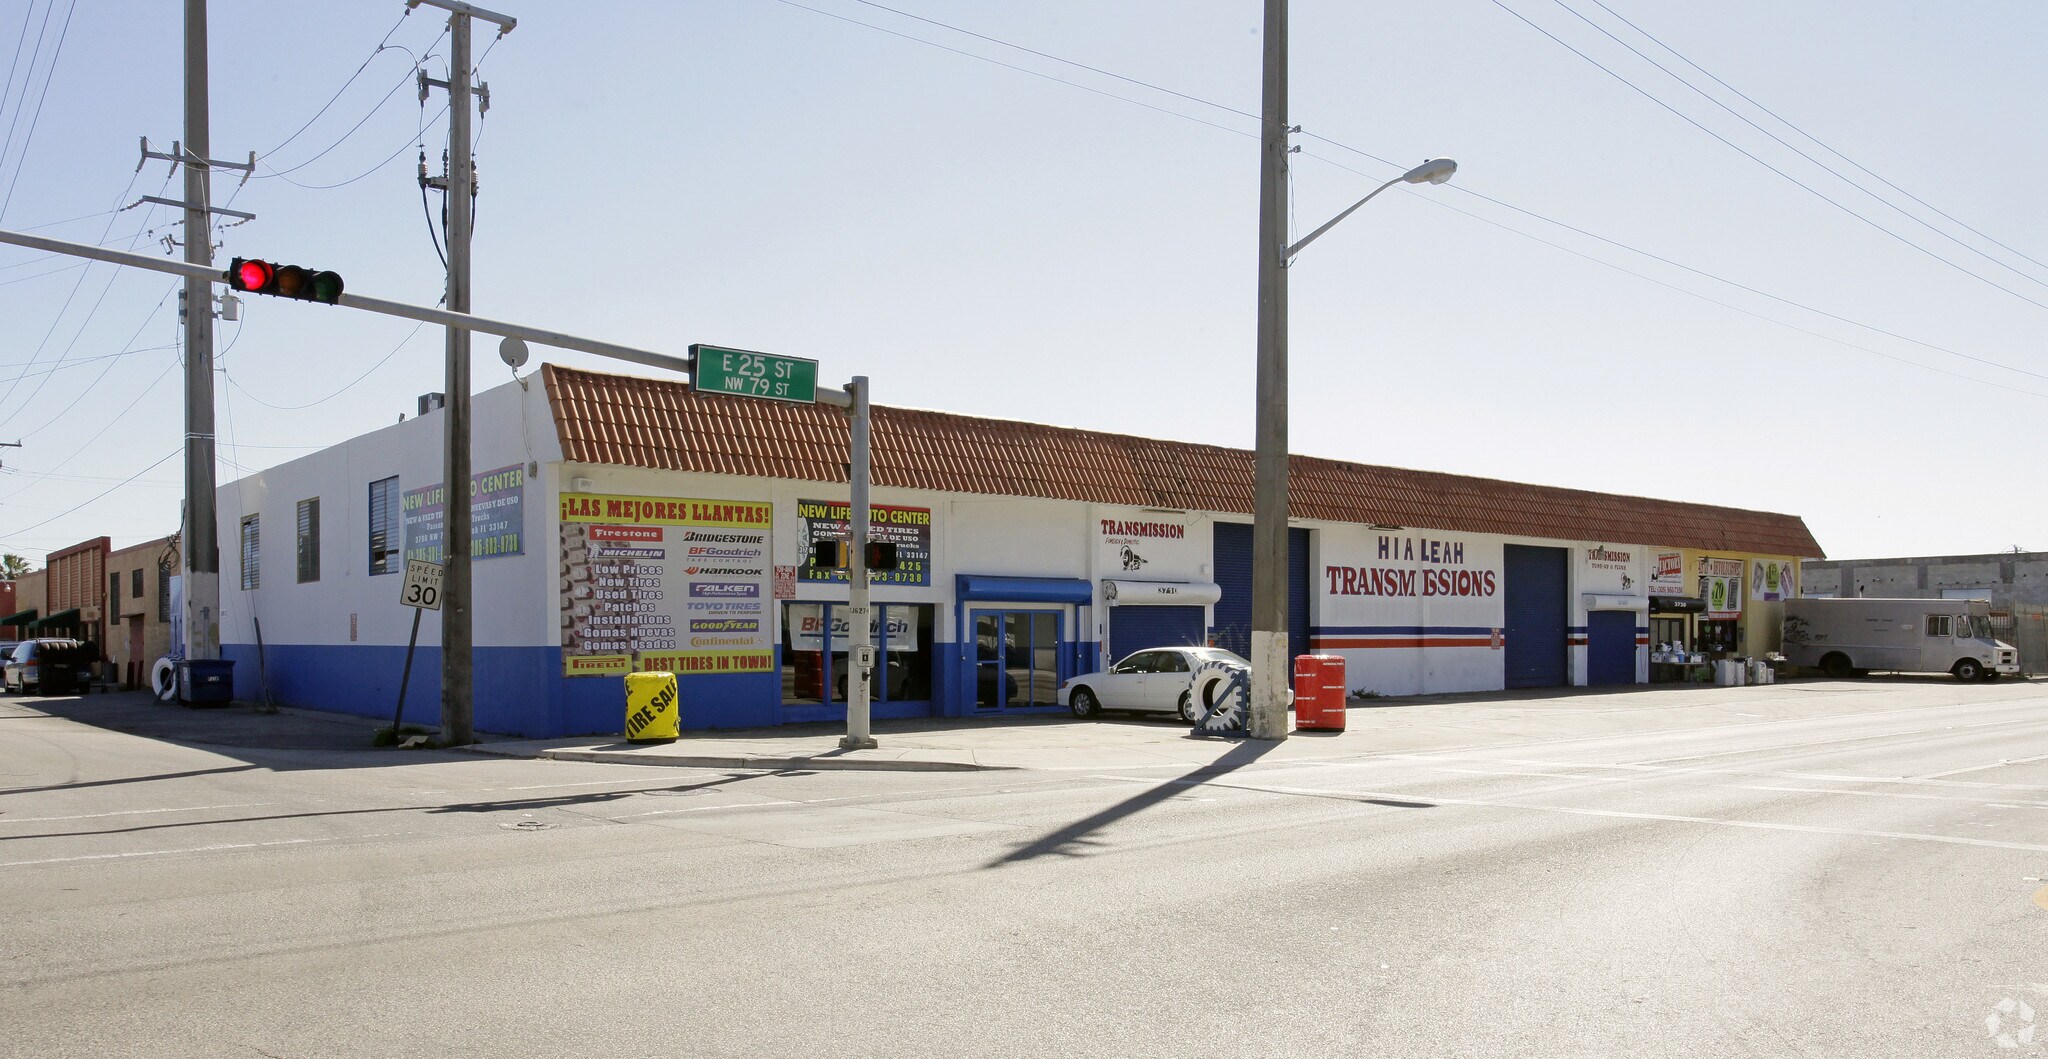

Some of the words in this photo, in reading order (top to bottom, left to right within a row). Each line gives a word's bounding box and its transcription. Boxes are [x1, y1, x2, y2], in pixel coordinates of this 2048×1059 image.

[723, 353, 733, 372] E
[738, 354, 766, 377] 25
[775, 361, 794, 379] ST
[725, 376, 743, 391] NW
[750, 377, 770, 395] 79
[775, 383, 790, 396] ST
[481, 469, 523, 494] CENTER
[403, 492, 424, 511] NEW
[607, 499, 687, 522] MEJORES
[692, 503, 769, 524] LLANTAS!
[798, 503, 827, 518] NEW
[890, 510, 930, 525] CENTER
[594, 528, 658, 538] Firestone
[886, 526, 919, 534] TIRES
[1100, 519, 1185, 539] TRANSMISSION
[683, 531, 764, 544] BRIDGESTONE
[602, 549, 664, 557] MICHELIN
[688, 546, 761, 557] BFGoodrich
[410, 564, 444, 577] SPEED
[595, 564, 619, 574] Low
[623, 564, 663, 575] Prices
[809, 569, 830, 580] Fax
[411, 574, 439, 586] LIMIT
[598, 577, 624, 587] New
[629, 577, 661, 587] Tires
[407, 584, 437, 605] 30
[595, 589, 627, 600] Used
[631, 589, 663, 600] Tires
[604, 602, 656, 612] Patches
[687, 602, 723, 610] TOYO
[724, 602, 761, 610] TIRES
[588, 615, 672, 625] Installations
[692, 621, 758, 630] GOODYEAR
[583, 627, 627, 638] Gomas
[630, 627, 676, 637] Nuevas
[583, 640, 627, 650] Gomas
[630, 639, 676, 650] Usadas
[690, 636, 754, 647] Continental
[644, 656, 676, 672] BEST
[678, 656, 714, 671] TIRES
[717, 656, 729, 670] IN
[733, 655, 772, 669] TOWN!
[626, 705, 657, 739] TIRE
